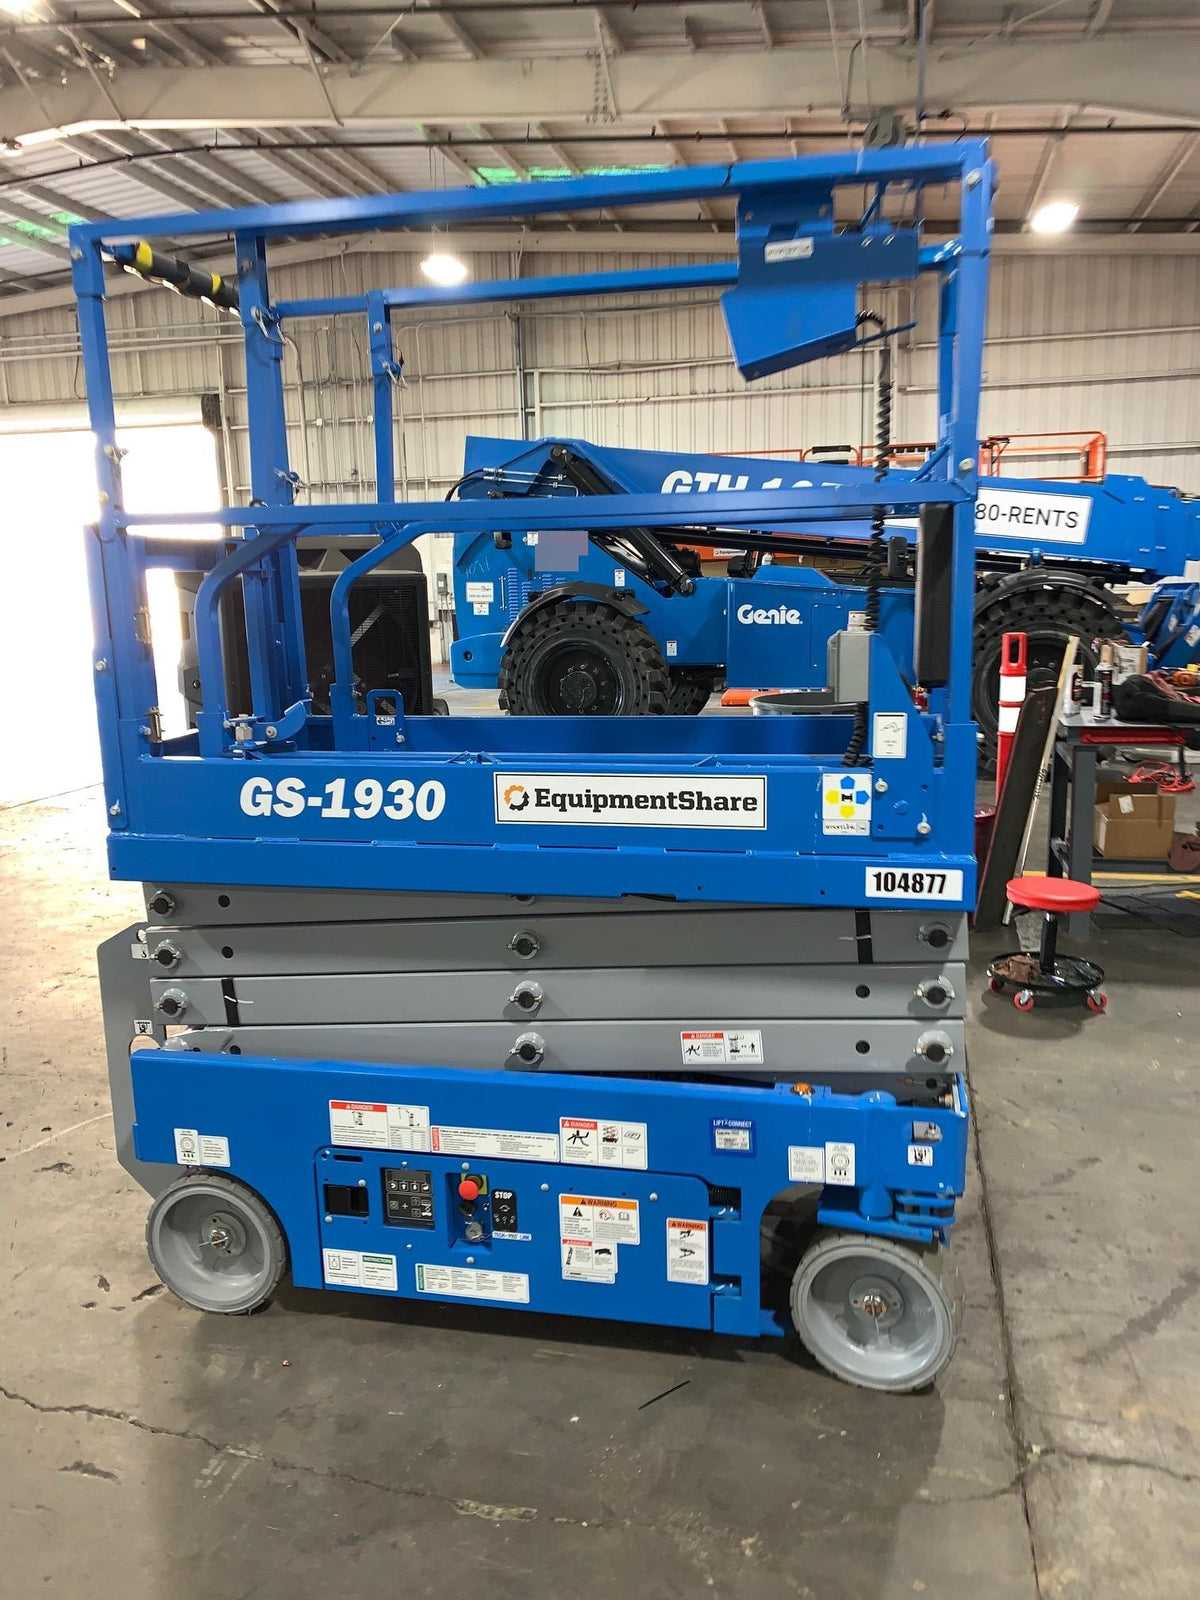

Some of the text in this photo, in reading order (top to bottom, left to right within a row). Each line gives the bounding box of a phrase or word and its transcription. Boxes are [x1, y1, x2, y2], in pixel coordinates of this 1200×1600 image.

[737, 604, 802, 625] Genie
[240, 777, 446, 821] GS-1930
[534, 788, 758, 812] EquipmentShare
[873, 872, 946, 894] 104877
[570, 1121, 595, 1129] DANGER
[495, 1191, 513, 1200] STOP
[588, 1199, 617, 1208] WARNING
